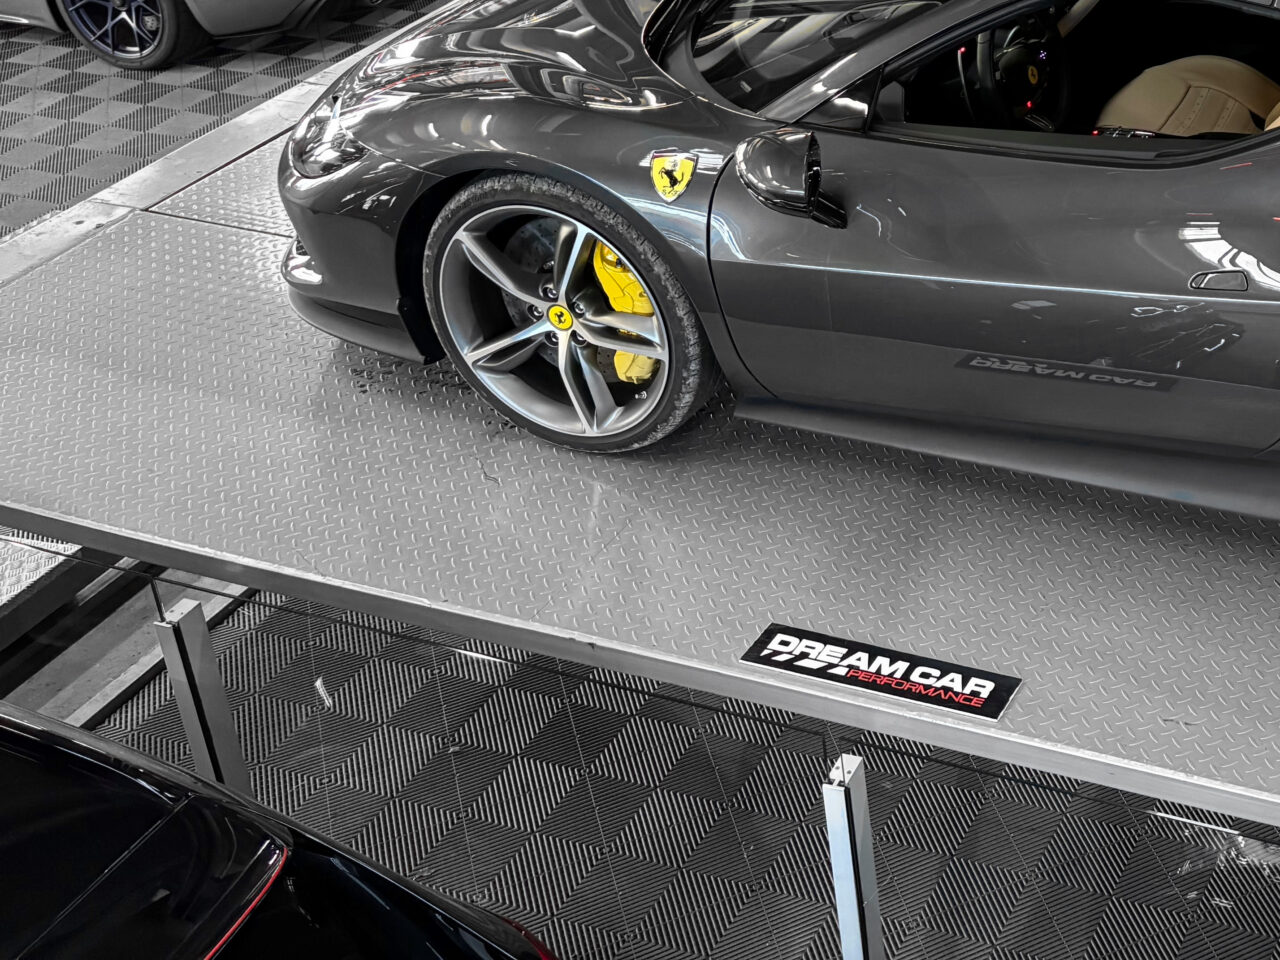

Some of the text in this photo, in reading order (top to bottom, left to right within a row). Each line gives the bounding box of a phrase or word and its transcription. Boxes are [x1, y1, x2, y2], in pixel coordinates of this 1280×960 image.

[766, 632, 996, 699] DREAM CAR
[846, 668, 986, 708] PERFORMANCE
